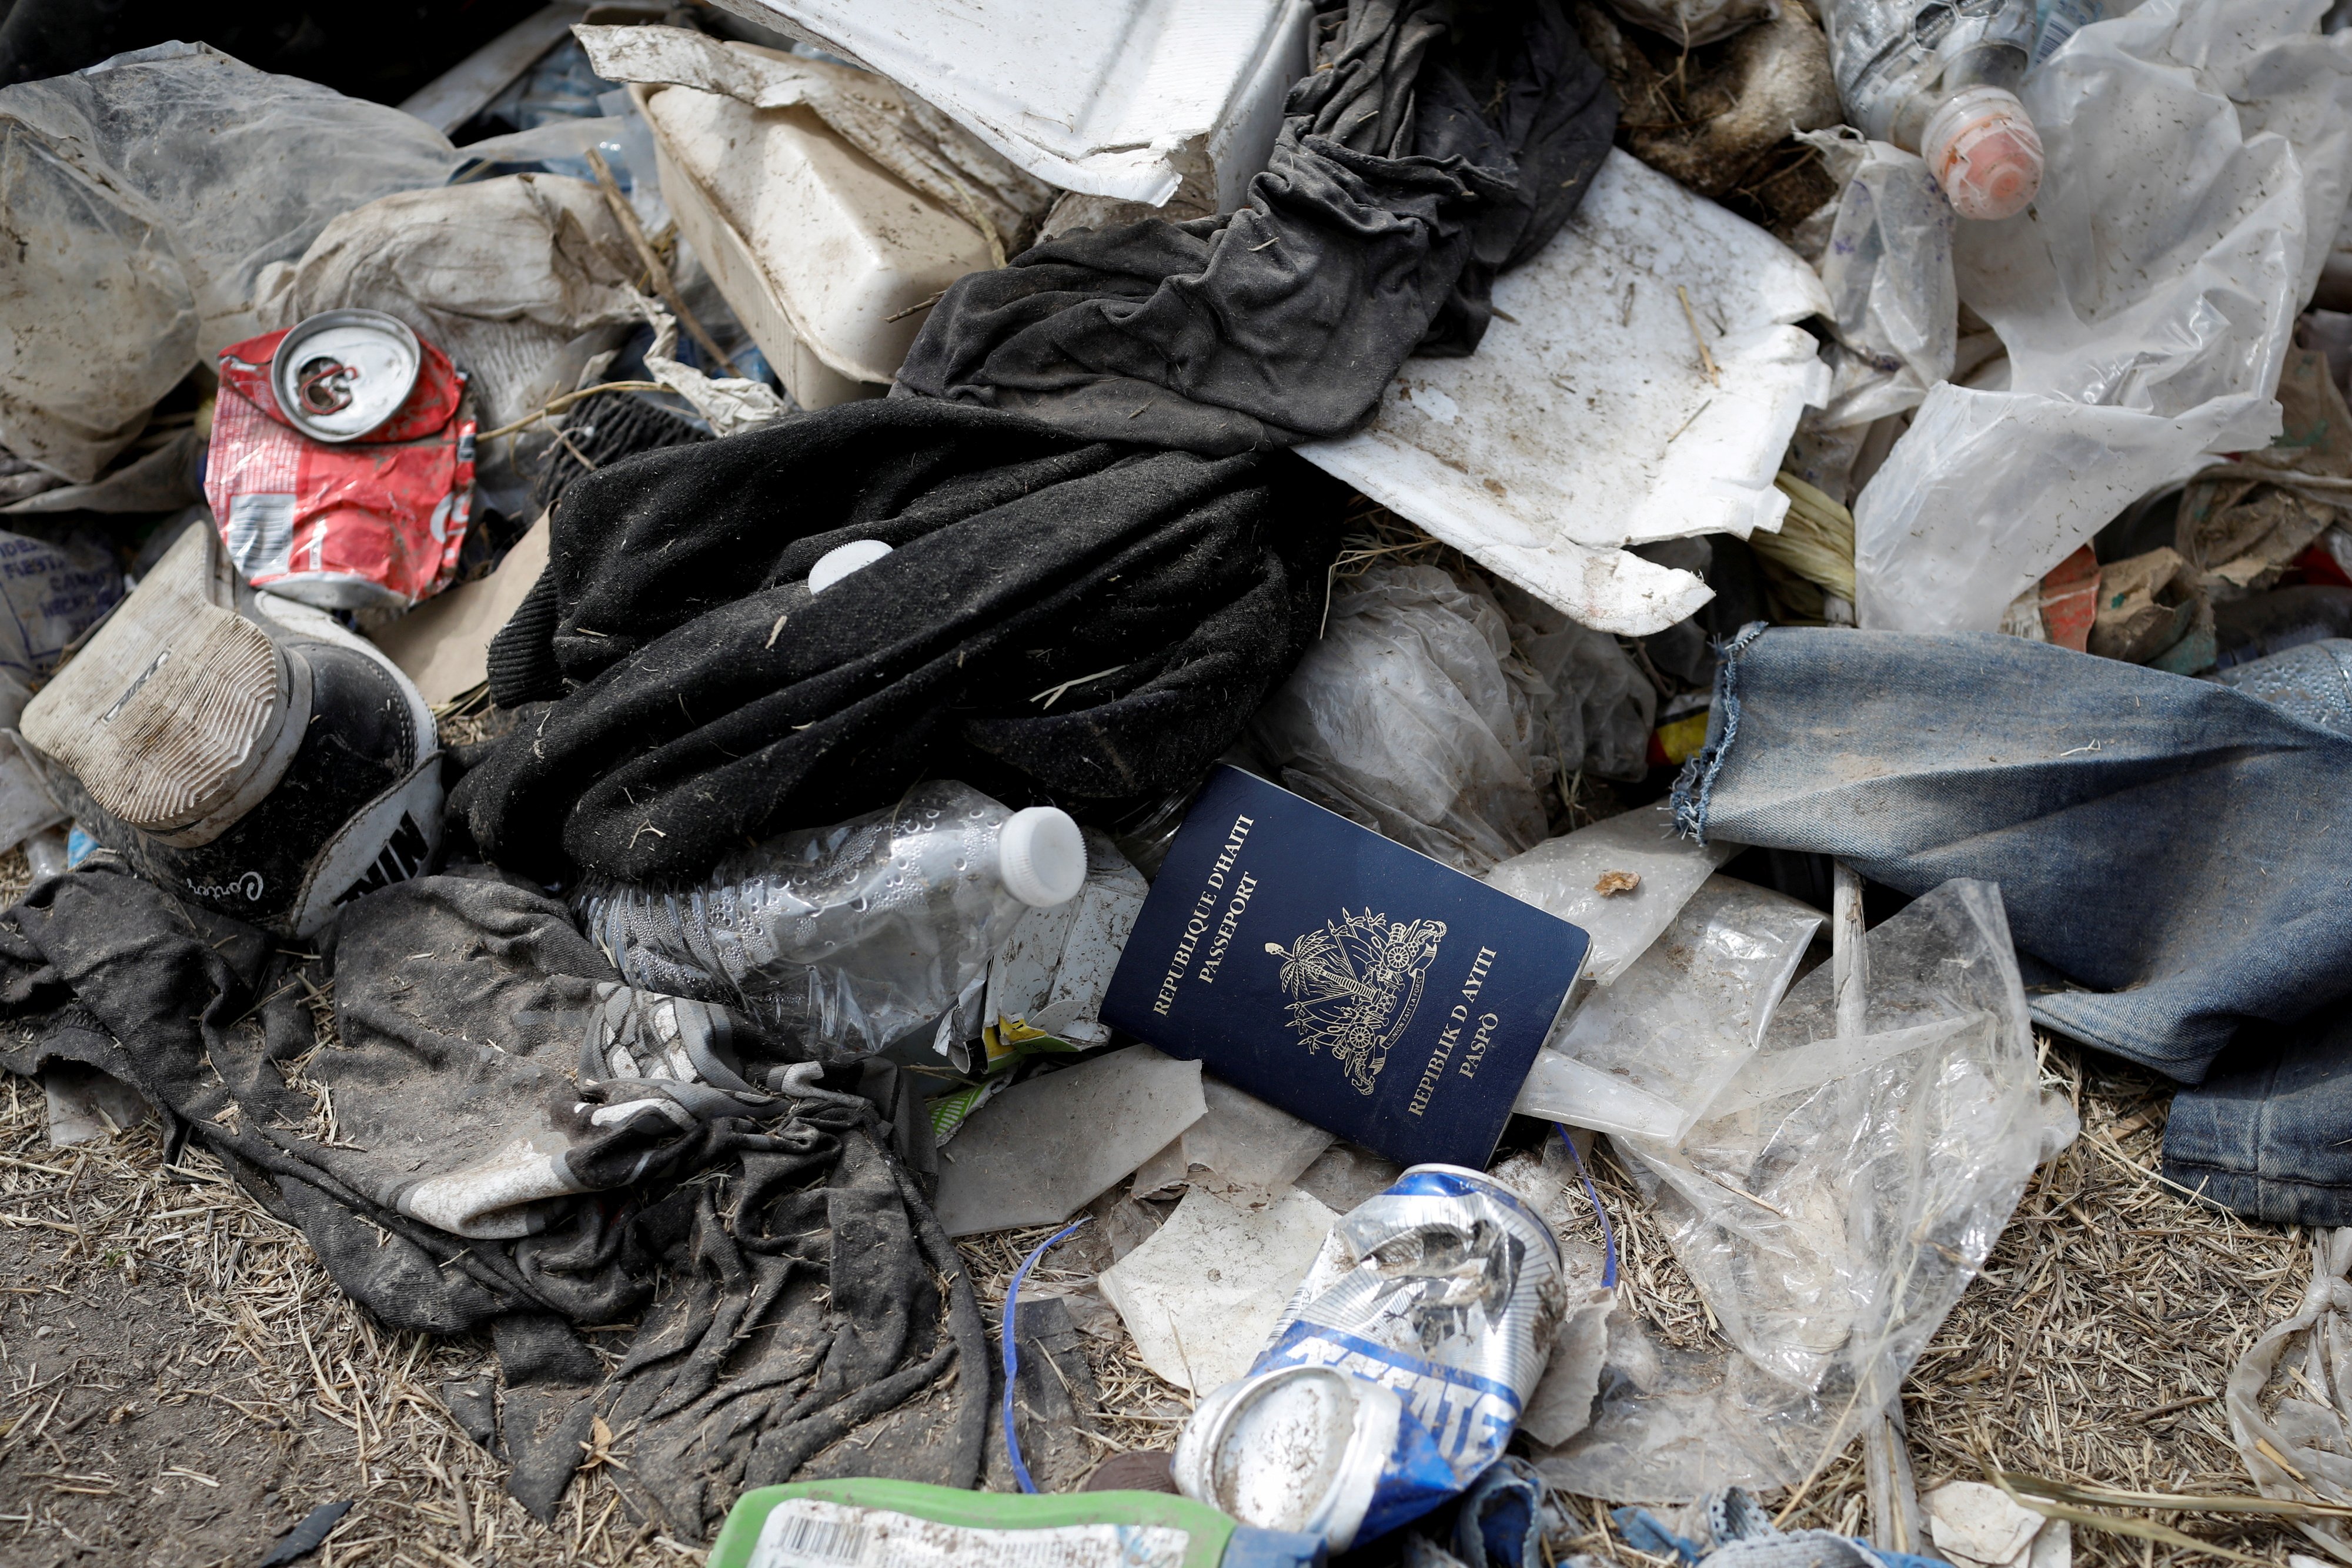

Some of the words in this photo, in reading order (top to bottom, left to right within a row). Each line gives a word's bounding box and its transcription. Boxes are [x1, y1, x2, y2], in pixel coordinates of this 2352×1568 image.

[333, 810, 428, 907] NIK
[1153, 891, 1217, 1017] REPUBLIQUE
[1208, 814, 1254, 890] D'HAITI
[1198, 871, 1258, 984] PASSEPORT
[1386, 1022, 1405, 1045] L'UNION
[1402, 1008, 1412, 1022] FAIT
[1413, 975, 1422, 997] FORCE
[1408, 1023, 1461, 1117] REPIBLIK
[1451, 1004, 1468, 1023] D
[1462, 945, 1497, 1004] AYITI
[1459, 1012, 1499, 1079] PASPÒ
[1286, 1336, 1521, 1470] TATE
